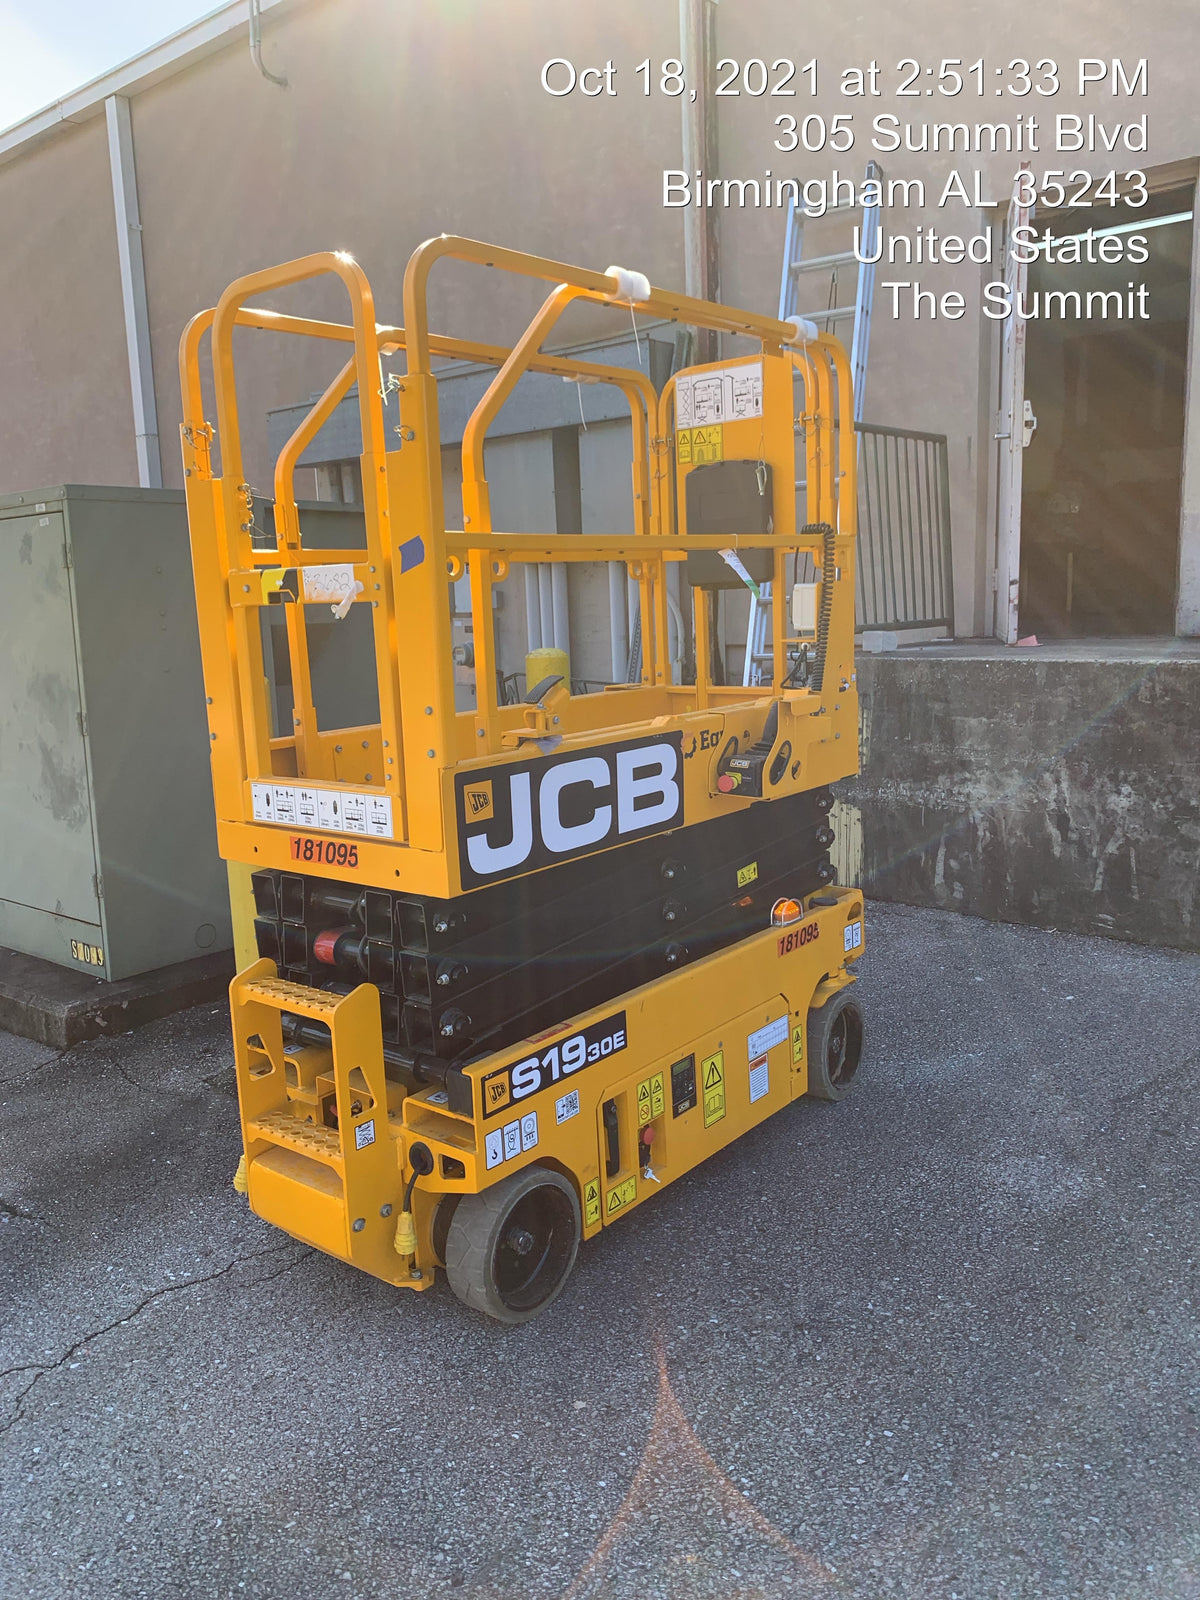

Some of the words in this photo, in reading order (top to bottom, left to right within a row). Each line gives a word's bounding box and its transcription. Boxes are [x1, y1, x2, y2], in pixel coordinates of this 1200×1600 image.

[466, 743, 680, 876] JCB
[470, 791, 490, 815] JCB
[293, 836, 359, 868] 181095
[780, 921, 820, 956] 181095
[490, 1082, 507, 1101] JCB
